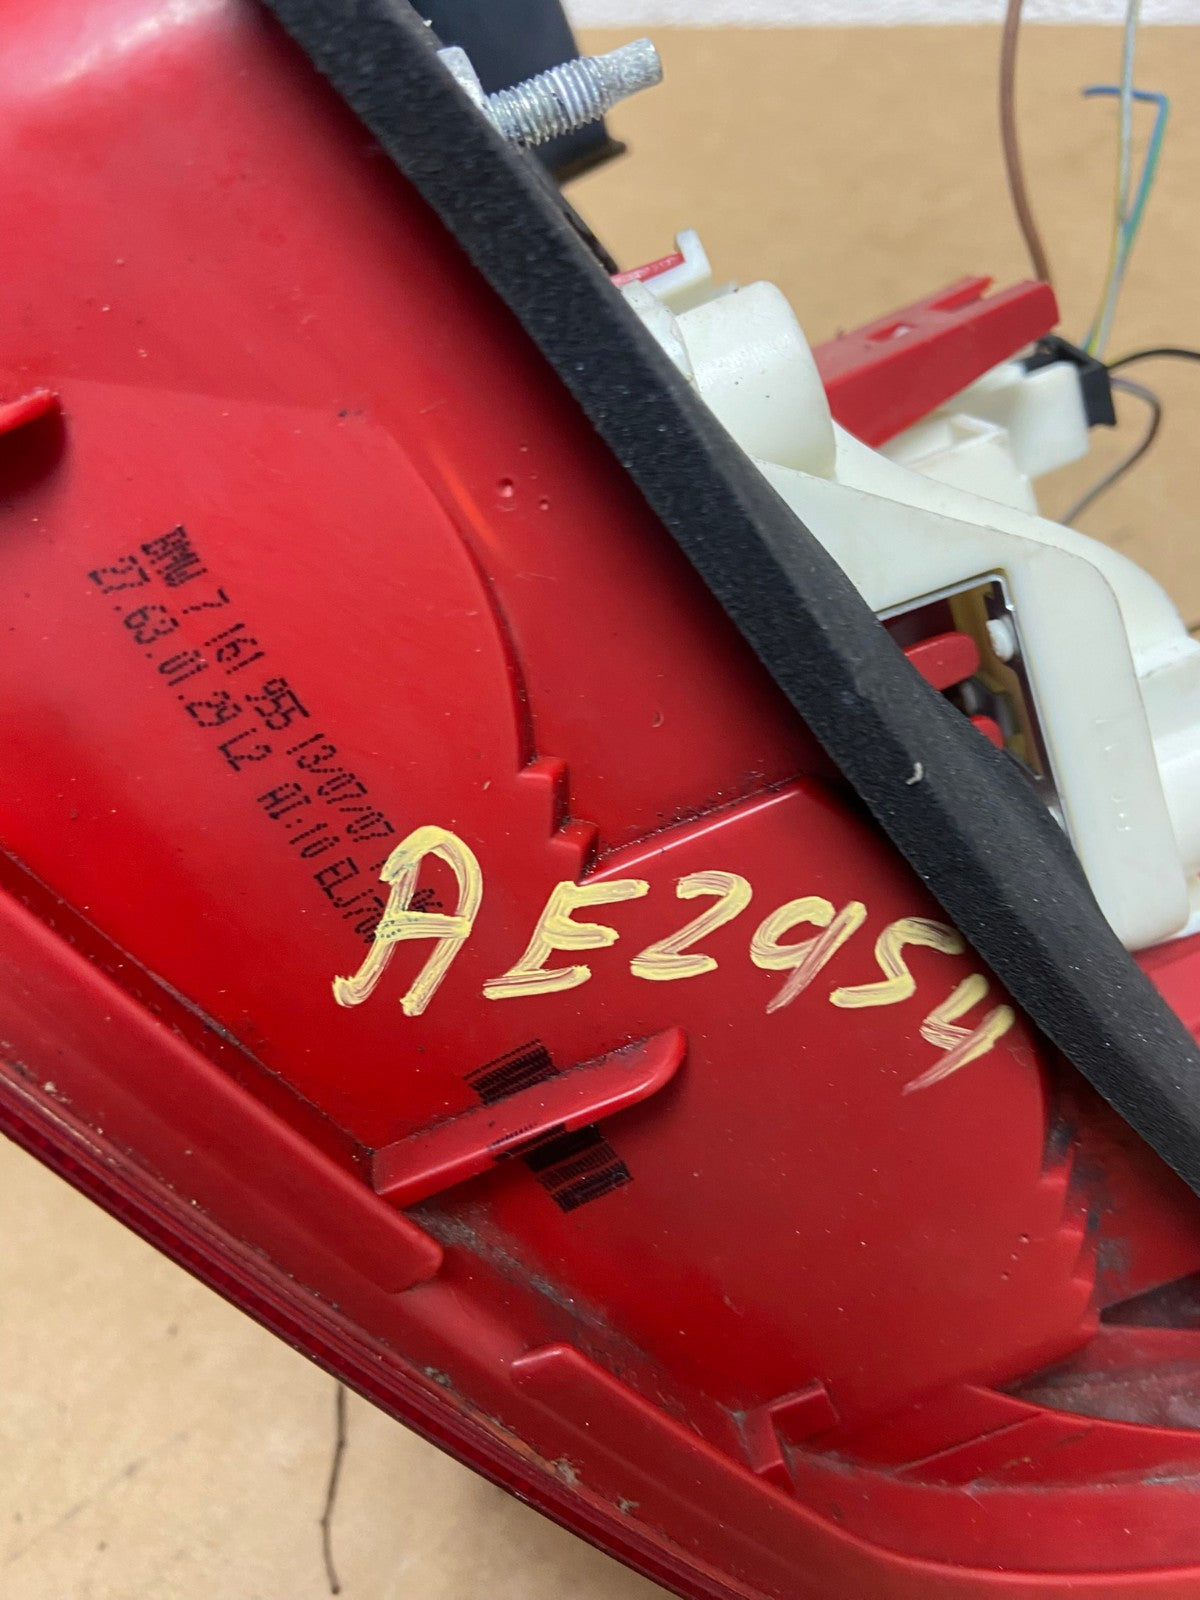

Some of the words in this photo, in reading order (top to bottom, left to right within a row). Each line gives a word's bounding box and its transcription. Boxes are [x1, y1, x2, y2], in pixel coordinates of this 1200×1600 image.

[140, 525, 208, 588] BMW
[182, 587, 230, 615] 7
[204, 622, 265, 675] 161
[245, 677, 310, 731] 955
[286, 732, 396, 843] 13/07/07
